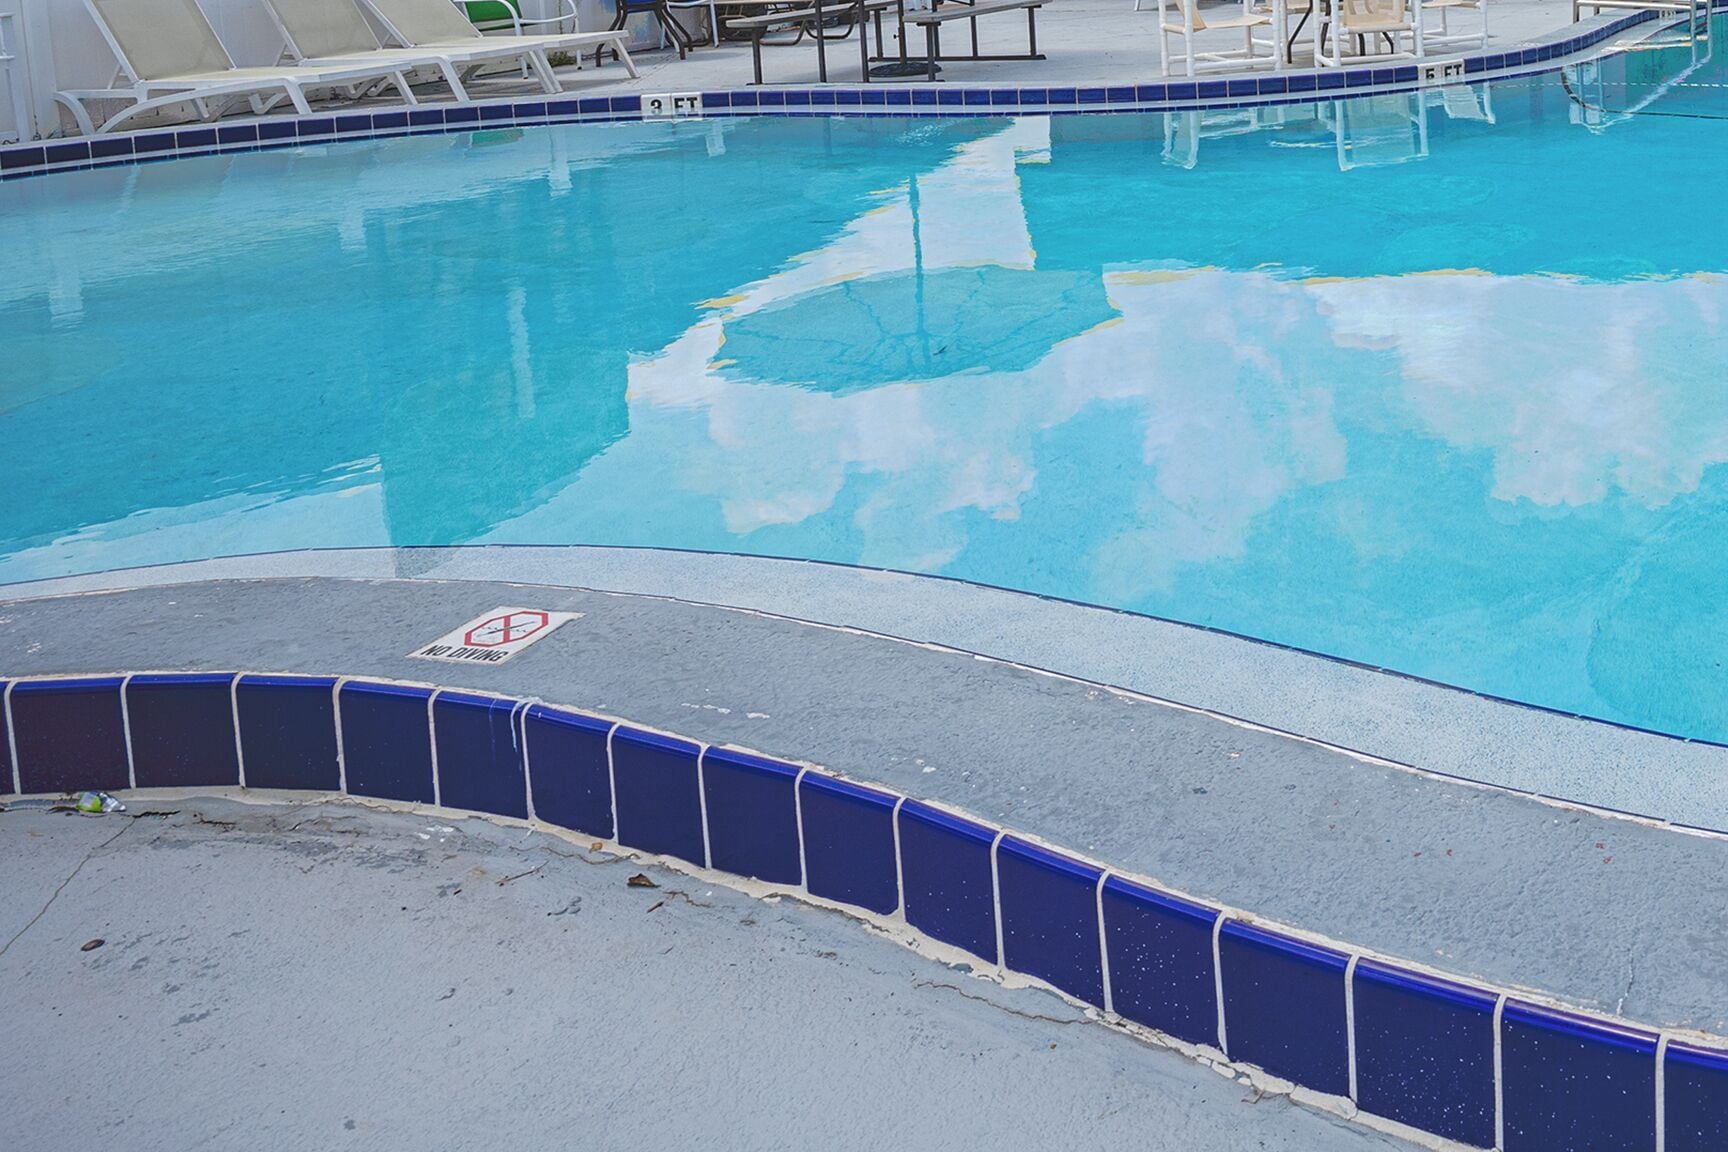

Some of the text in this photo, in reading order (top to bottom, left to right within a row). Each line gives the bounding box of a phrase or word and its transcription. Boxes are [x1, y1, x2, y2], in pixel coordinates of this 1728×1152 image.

[1425, 64, 1463, 80] 5 FT
[650, 97, 698, 114] 3 FT
[420, 645, 509, 663] NO DIVING
